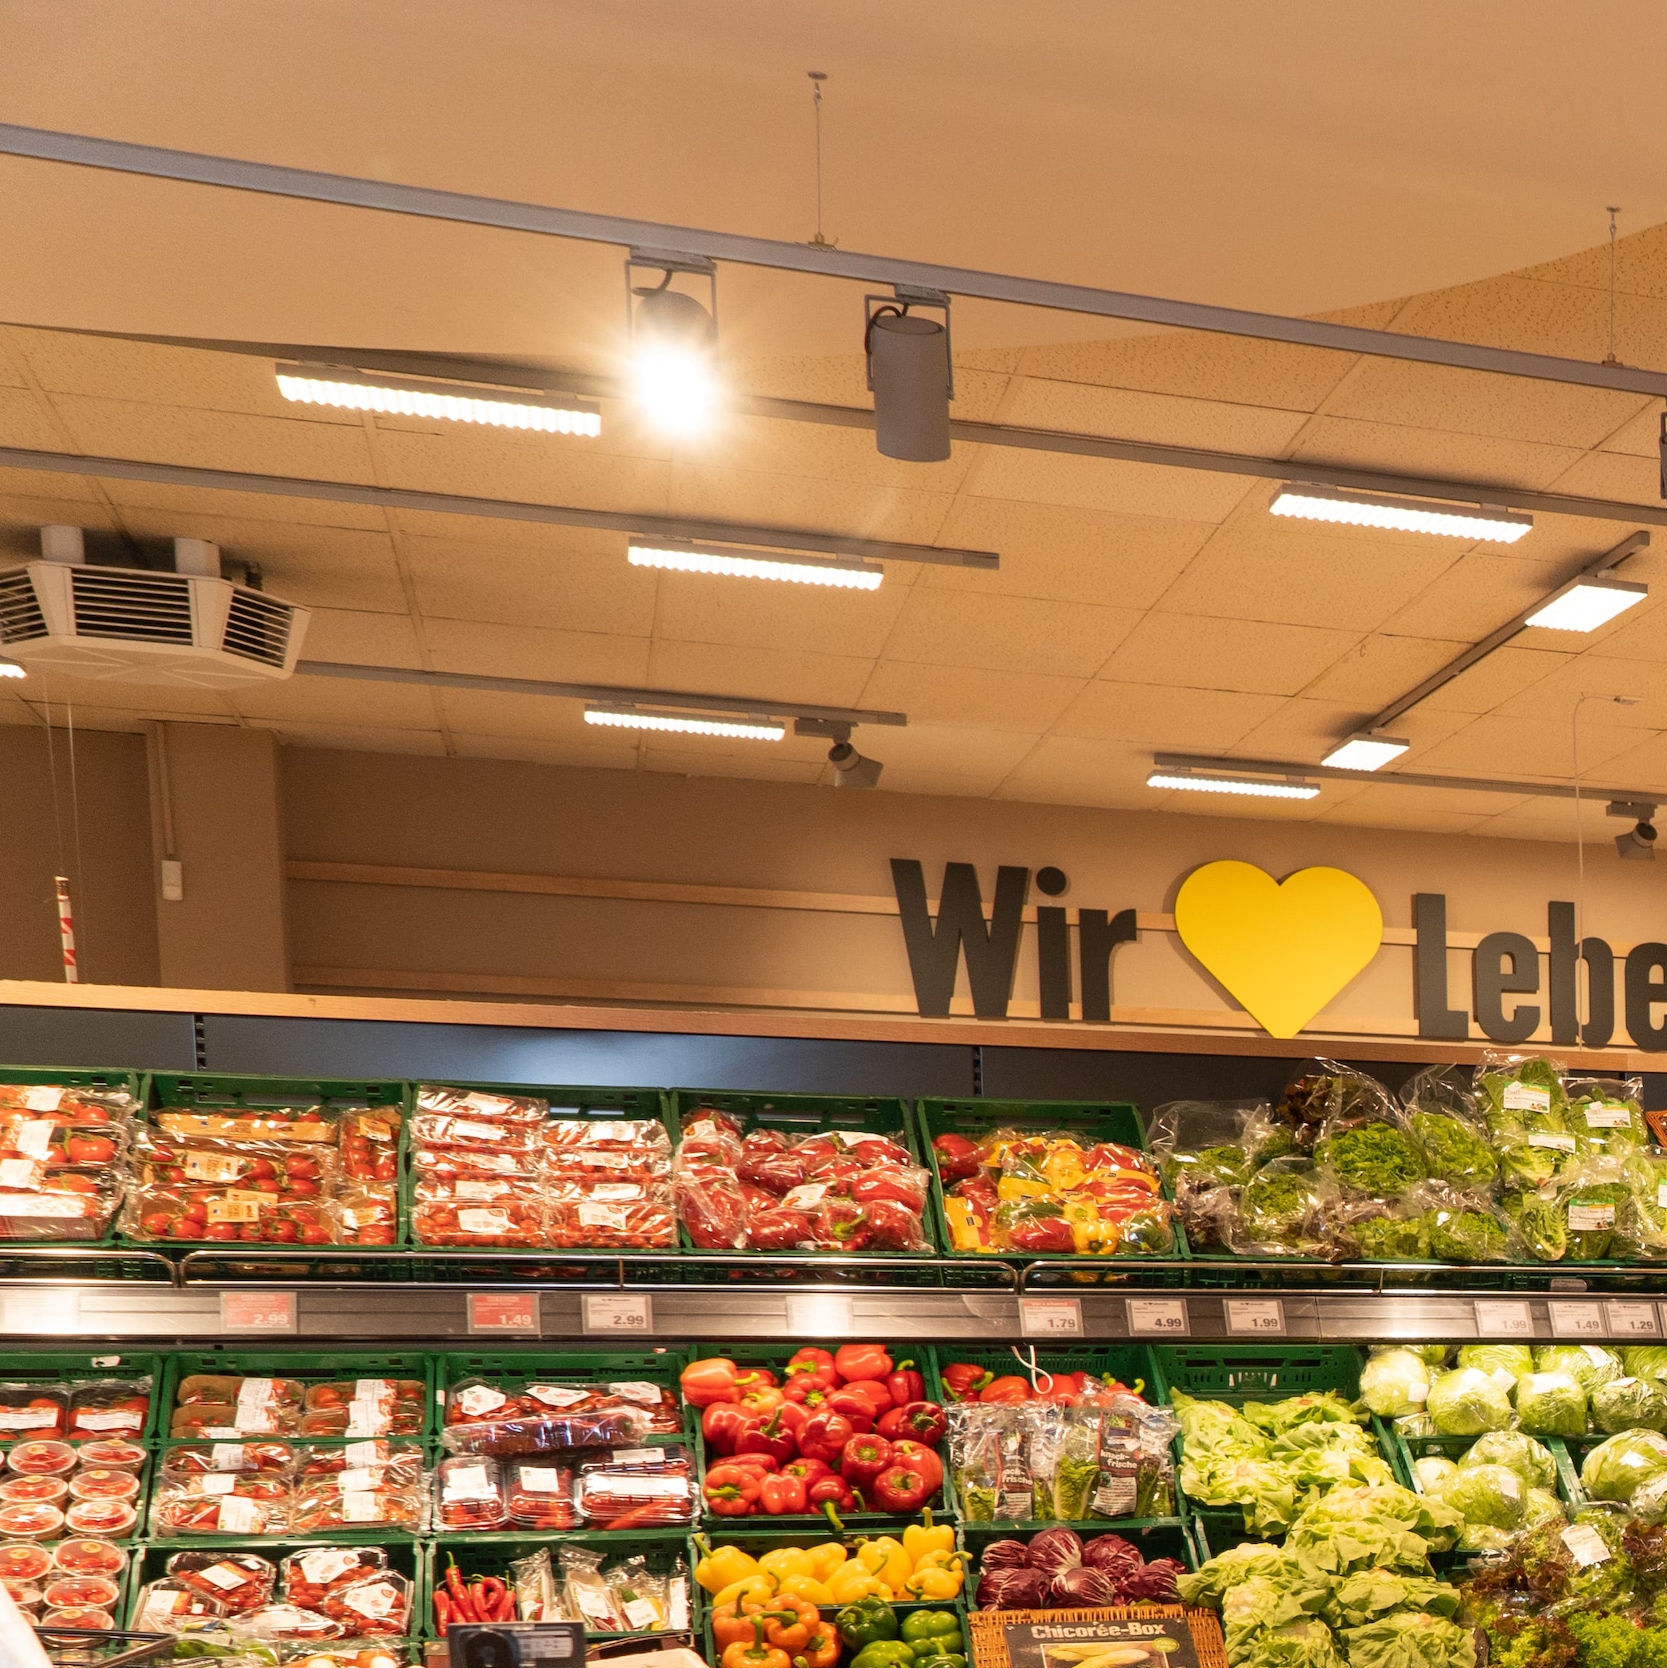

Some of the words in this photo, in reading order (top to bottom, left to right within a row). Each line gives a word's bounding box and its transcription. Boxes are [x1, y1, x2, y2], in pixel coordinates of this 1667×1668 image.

[890, 858, 1136, 1023] Wir
[253, 1313, 288, 1325] 2.99
[500, 1314, 531, 1325] 1.49
[613, 1315, 644, 1325] 2.99
[1049, 1318, 1076, 1328] 1.79
[1155, 1318, 1182, 1327] 4.99
[1251, 1318, 1278, 1327] 1.99
[1502, 1320, 1527, 1329] 1.99
[1575, 1320, 1600, 1329] 1.49
[1630, 1320, 1653, 1330] 1.29
[1002, 1467, 1026, 1476] ack-
[1031, 1622, 1166, 1639] Chicorée-Box
